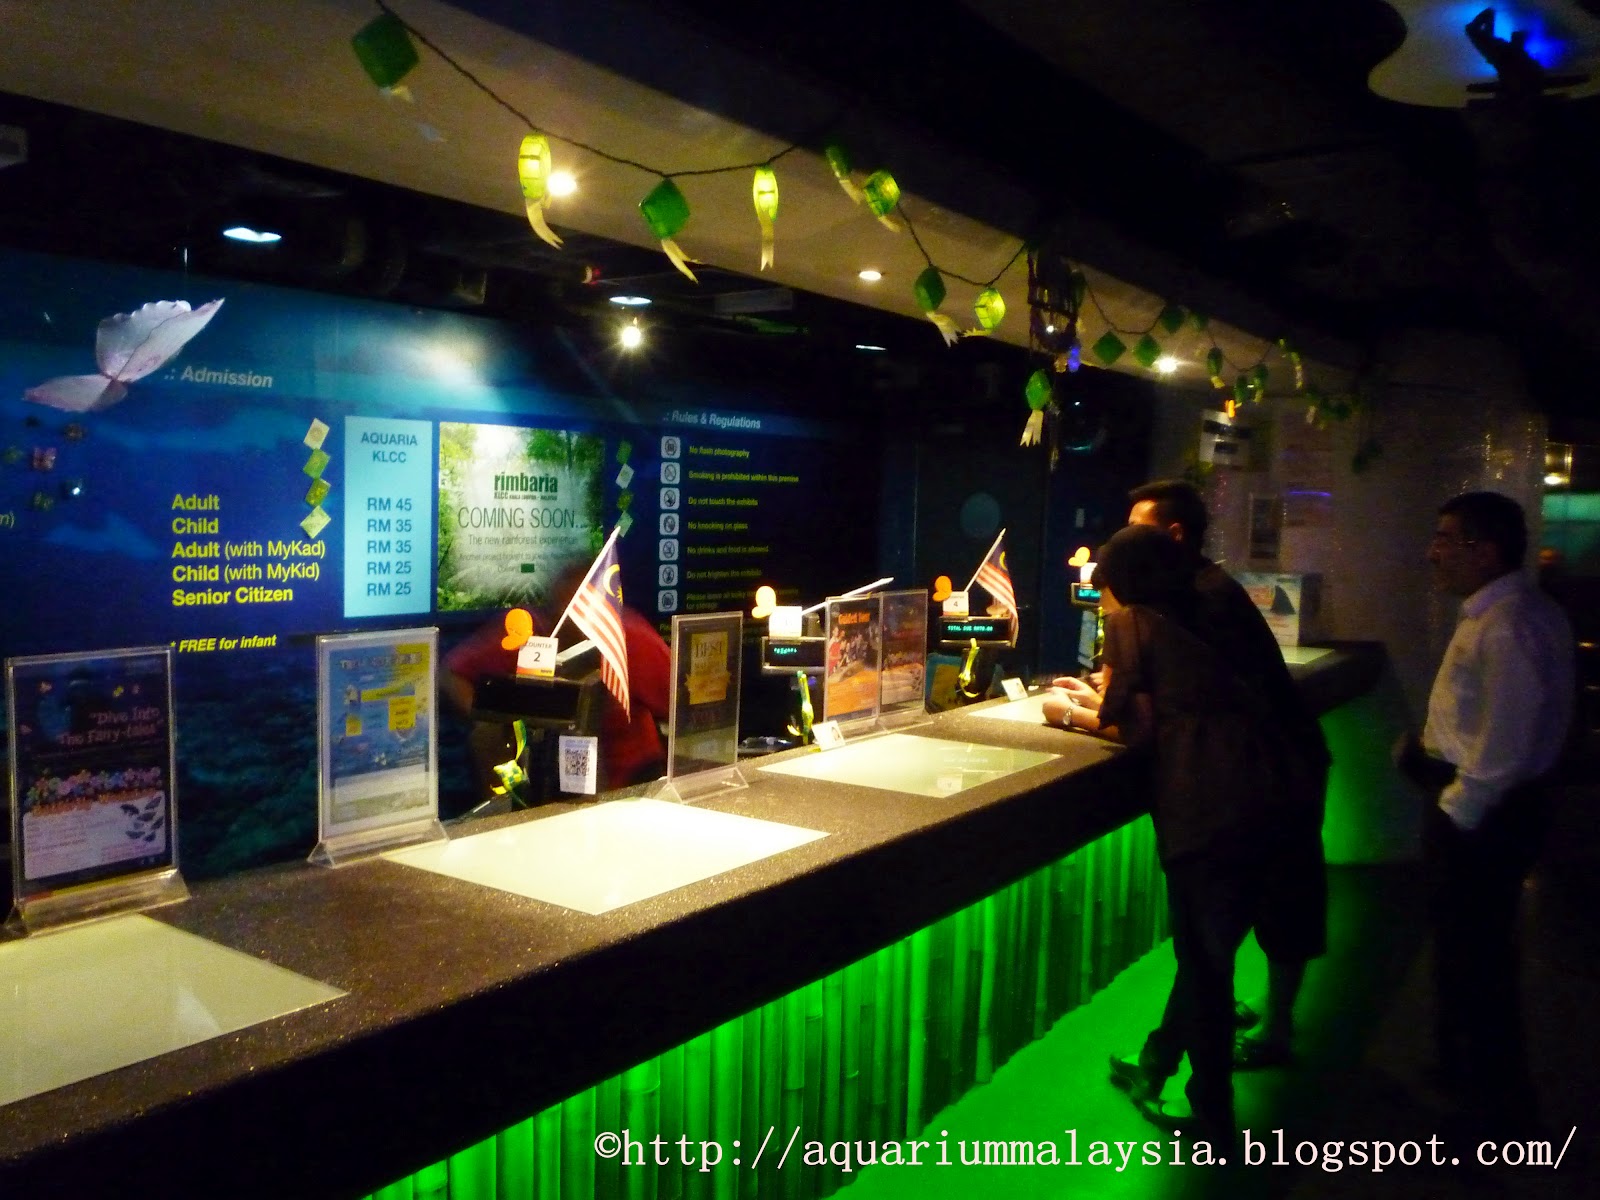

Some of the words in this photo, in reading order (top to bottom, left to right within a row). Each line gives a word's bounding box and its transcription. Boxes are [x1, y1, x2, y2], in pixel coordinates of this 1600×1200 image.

[181, 365, 274, 388] Admission
[672, 409, 699, 424] Rules
[700, 412, 707, 424] &
[709, 412, 761, 429] Regulations
[361, 432, 418, 446] AQUARIA
[372, 450, 407, 463] KLCC
[494, 472, 558, 492] rimbaria
[172, 494, 220, 510] Adult
[367, 497, 391, 511] RM
[396, 497, 412, 511] 45
[458, 507, 524, 528] COMING
[172, 518, 219, 534] Child
[367, 519, 391, 532] RM
[396, 519, 412, 532] 35
[367, 540, 391, 553] RM
[396, 540, 412, 553] 35
[469, 534, 482, 545] The
[484, 537, 499, 545] new
[172, 542, 220, 558] Adult
[225, 541, 263, 560] (with
[267, 540, 326, 560] MyKad)
[172, 565, 219, 582] Child
[224, 564, 262, 584] (with
[267, 562, 320, 583] MyKid)
[367, 561, 391, 575] RM
[396, 561, 412, 575] 25
[172, 588, 231, 606] Senior
[235, 586, 293, 603] Citizen
[367, 582, 391, 596] RM
[396, 582, 412, 596] 25
[179, 637, 217, 653] FREE
[219, 637, 238, 650] for
[240, 634, 277, 649] infant
[526, 641, 553, 649] OUNTER
[533, 651, 541, 663] 2
